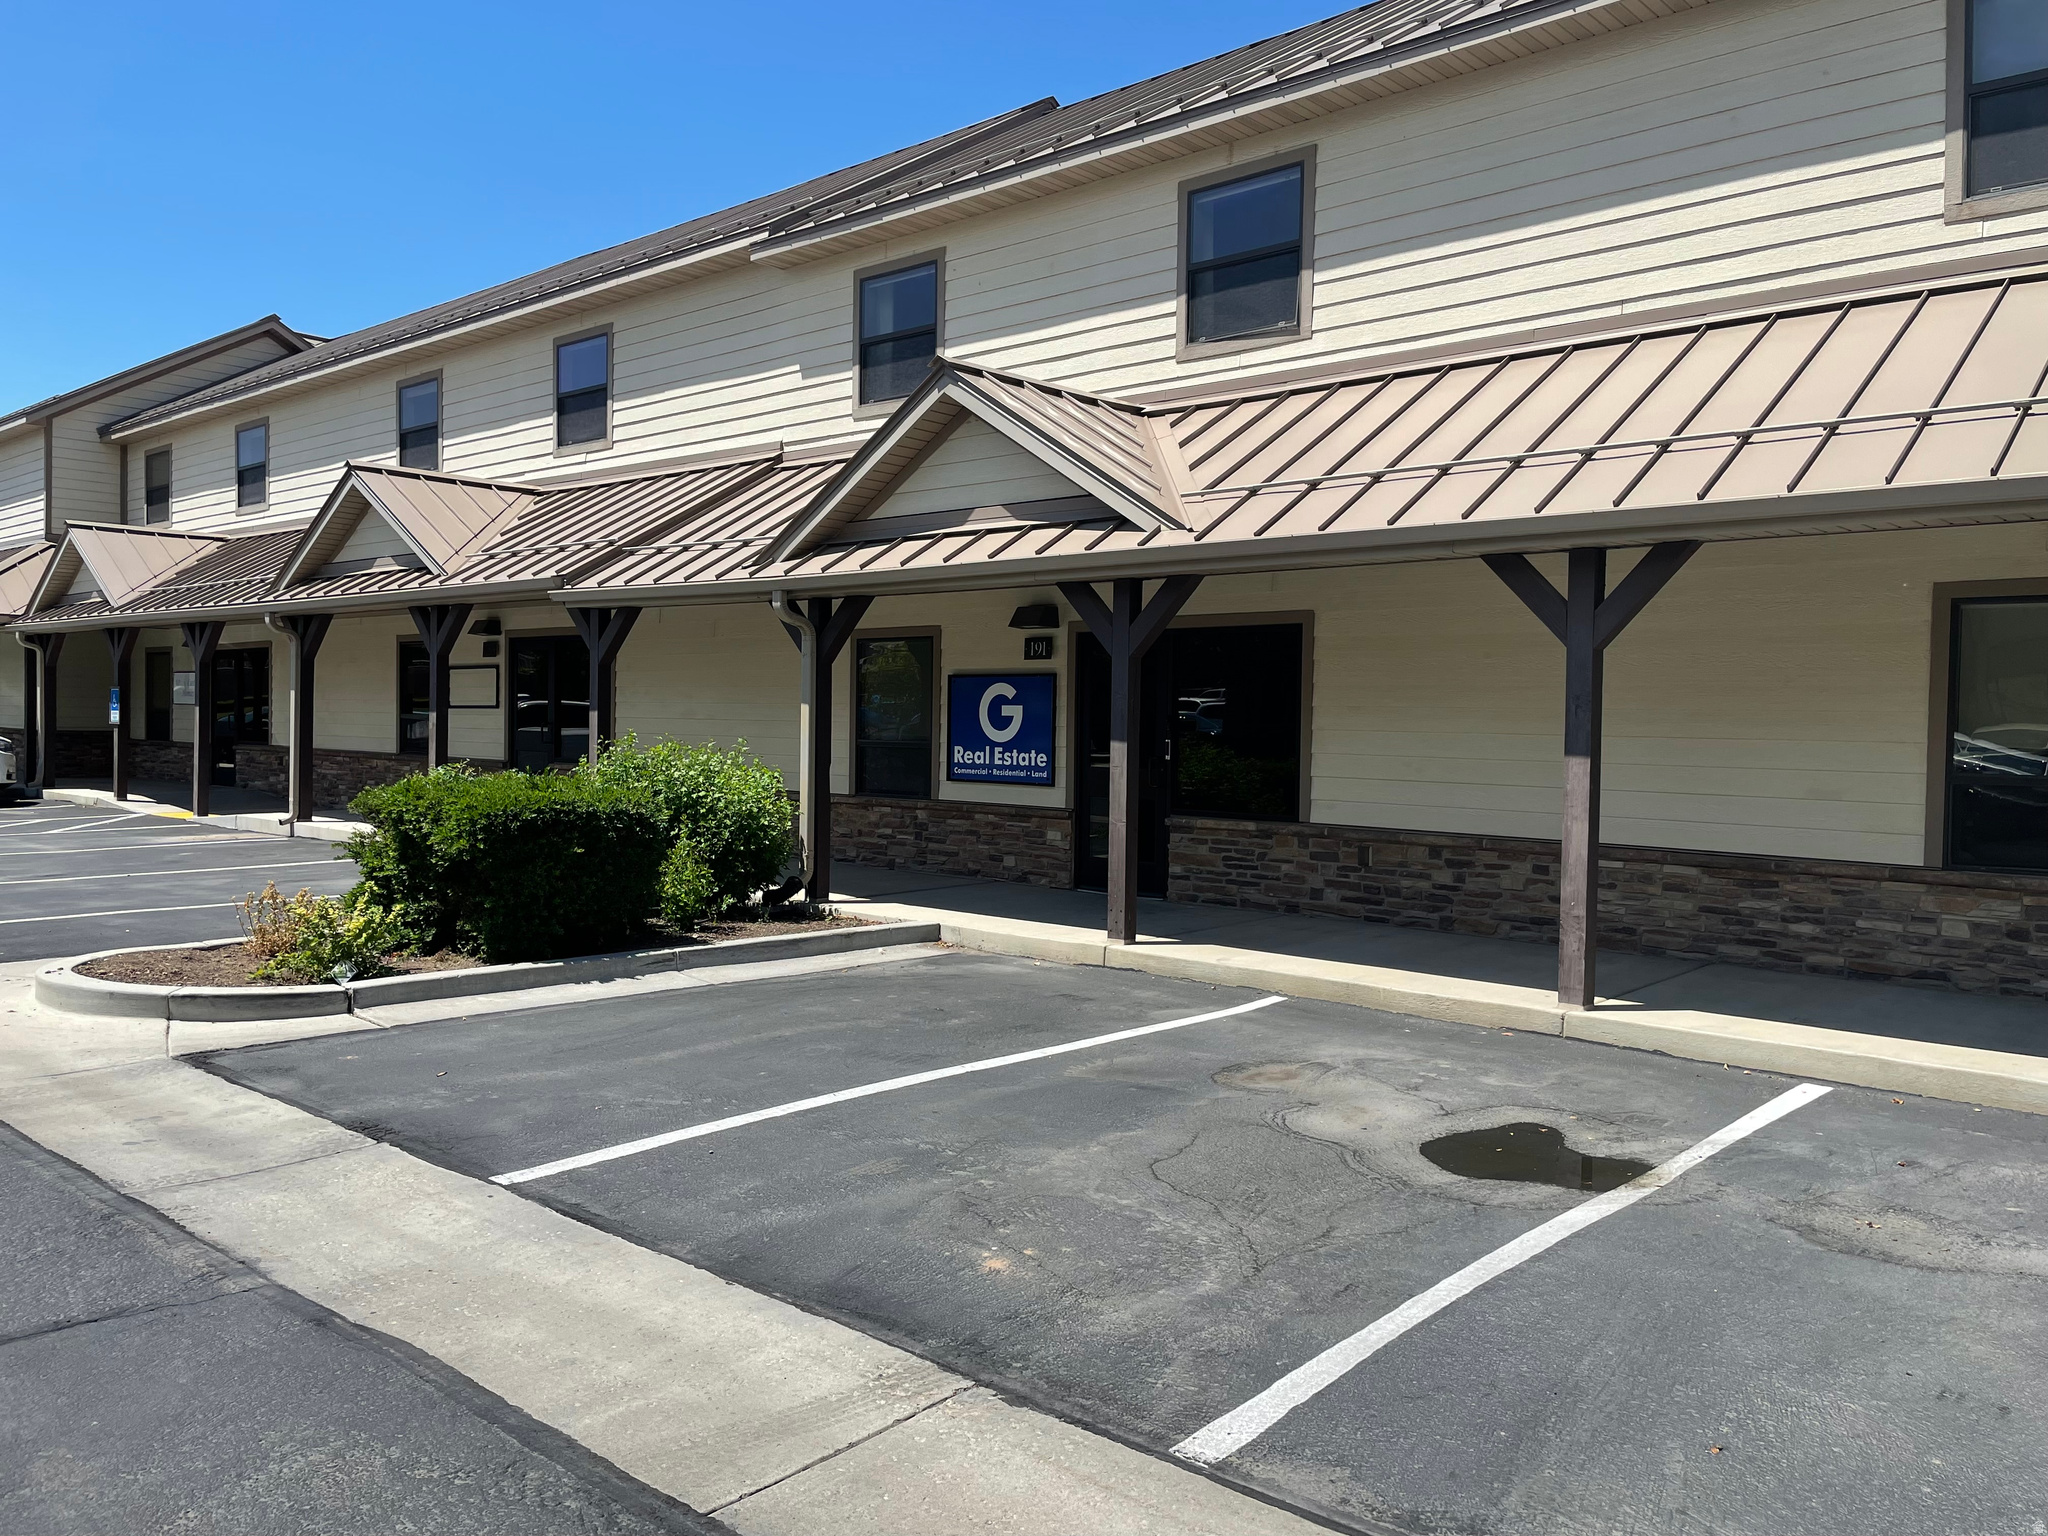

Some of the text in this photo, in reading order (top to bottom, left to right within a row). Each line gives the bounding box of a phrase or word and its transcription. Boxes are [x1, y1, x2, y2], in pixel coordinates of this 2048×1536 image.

[1030, 641, 1046, 656] 191
[979, 682, 1023, 743] G
[954, 745, 1047, 767] Real Estate
[954, 767, 1047, 778] Commercial Residential Land
